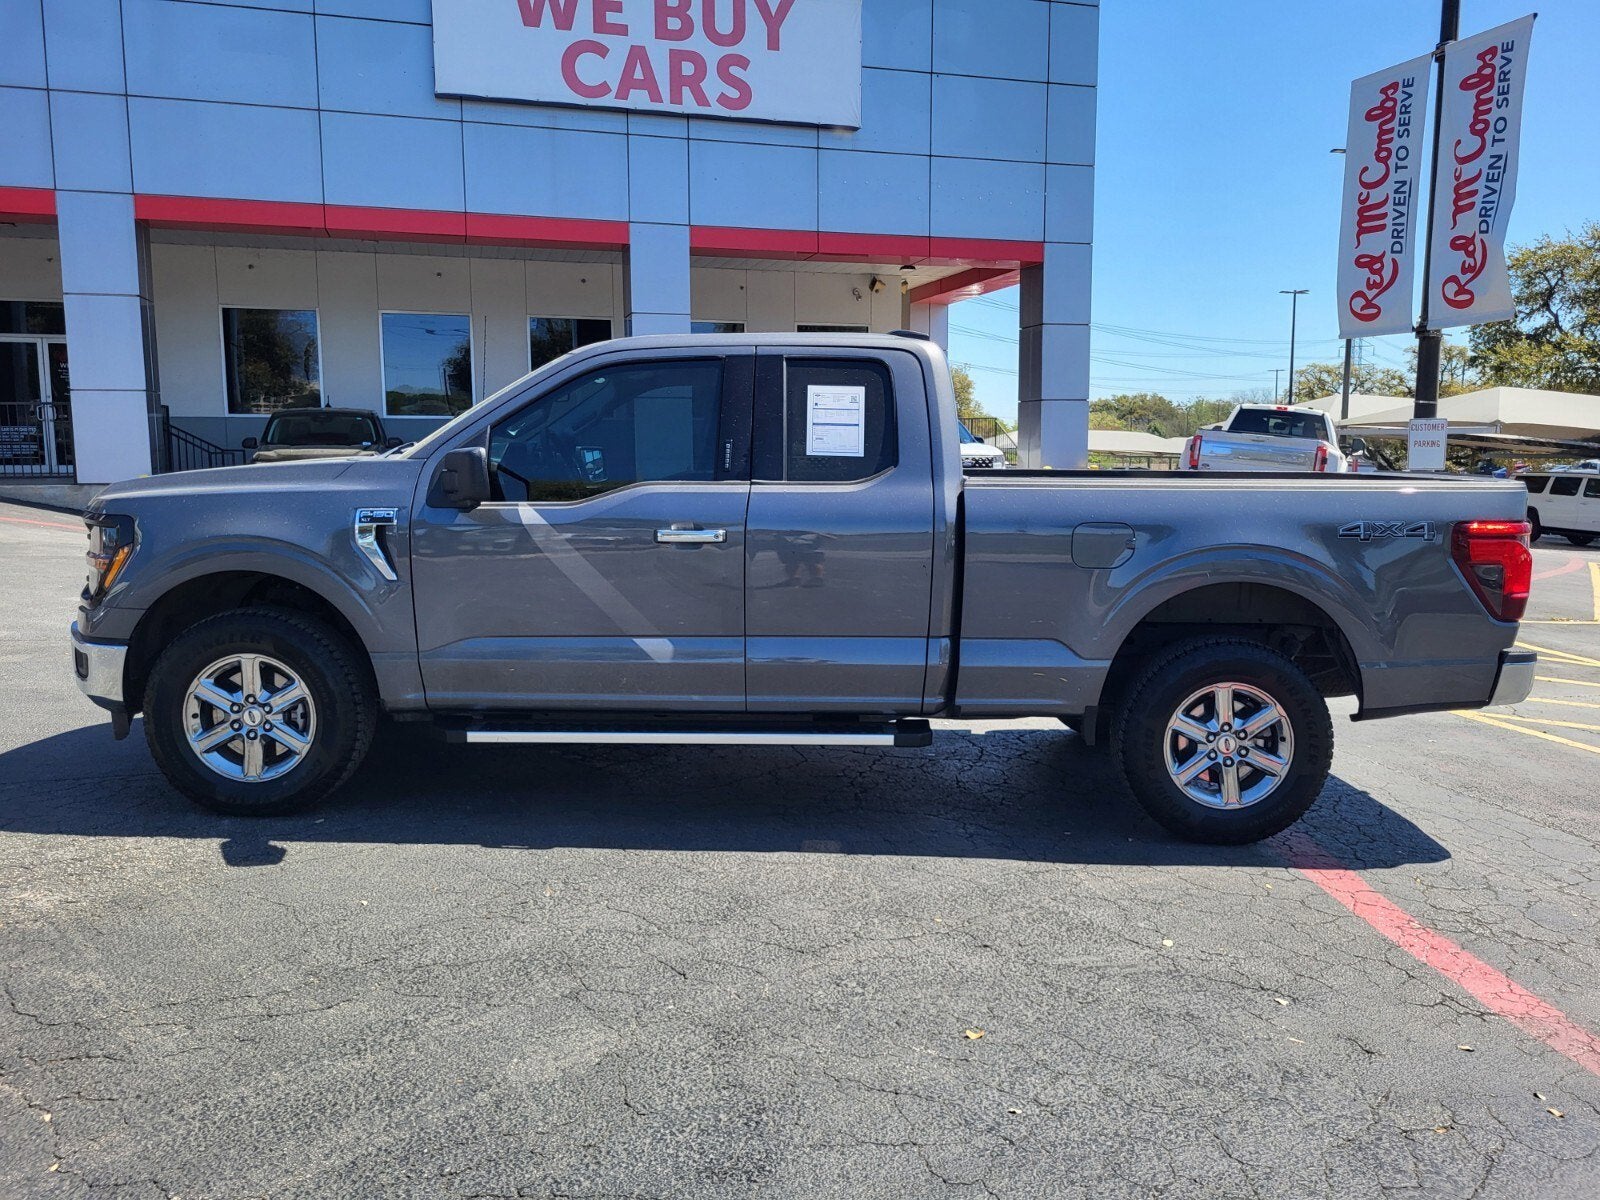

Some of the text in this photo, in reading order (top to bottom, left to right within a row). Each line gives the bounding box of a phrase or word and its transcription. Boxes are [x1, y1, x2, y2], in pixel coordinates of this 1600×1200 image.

[515, 0, 794, 52] WE BUY
[561, 39, 753, 111] CARS
[1390, 76, 1416, 254] DRIVEN TO SERVE
[1479, 40, 1515, 234] DRIVEN TO SERVE
[1349, 250, 1399, 322] Red
[1442, 231, 1488, 310] Red
[1411, 423, 1445, 431] CUSTOMER
